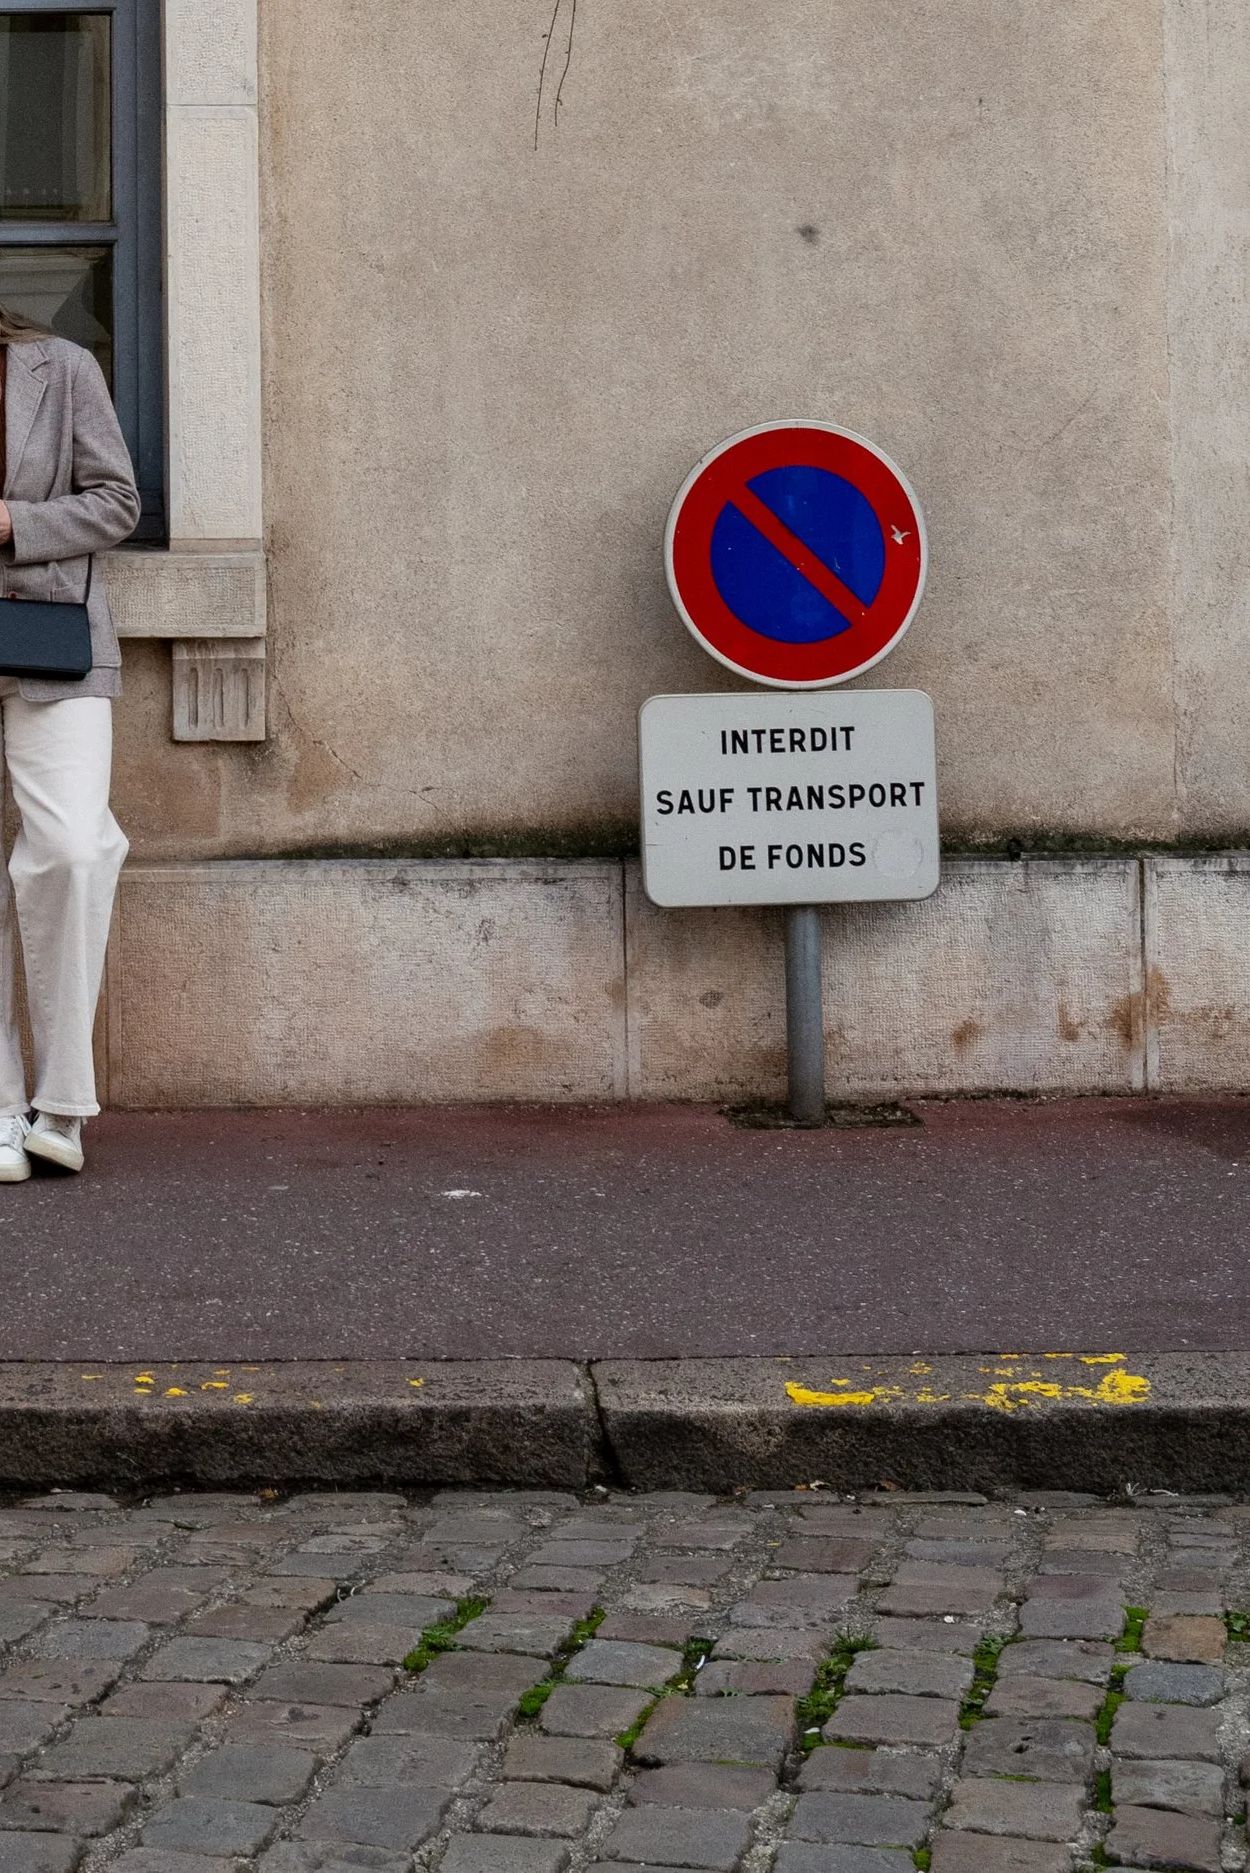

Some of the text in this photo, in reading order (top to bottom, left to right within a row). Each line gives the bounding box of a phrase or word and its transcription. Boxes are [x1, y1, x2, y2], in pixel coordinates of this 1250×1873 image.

[721, 726, 855, 755] INTERDIT
[656, 782, 925, 816] SAUF TRANSPORT
[719, 842, 867, 871] DE FONDS
